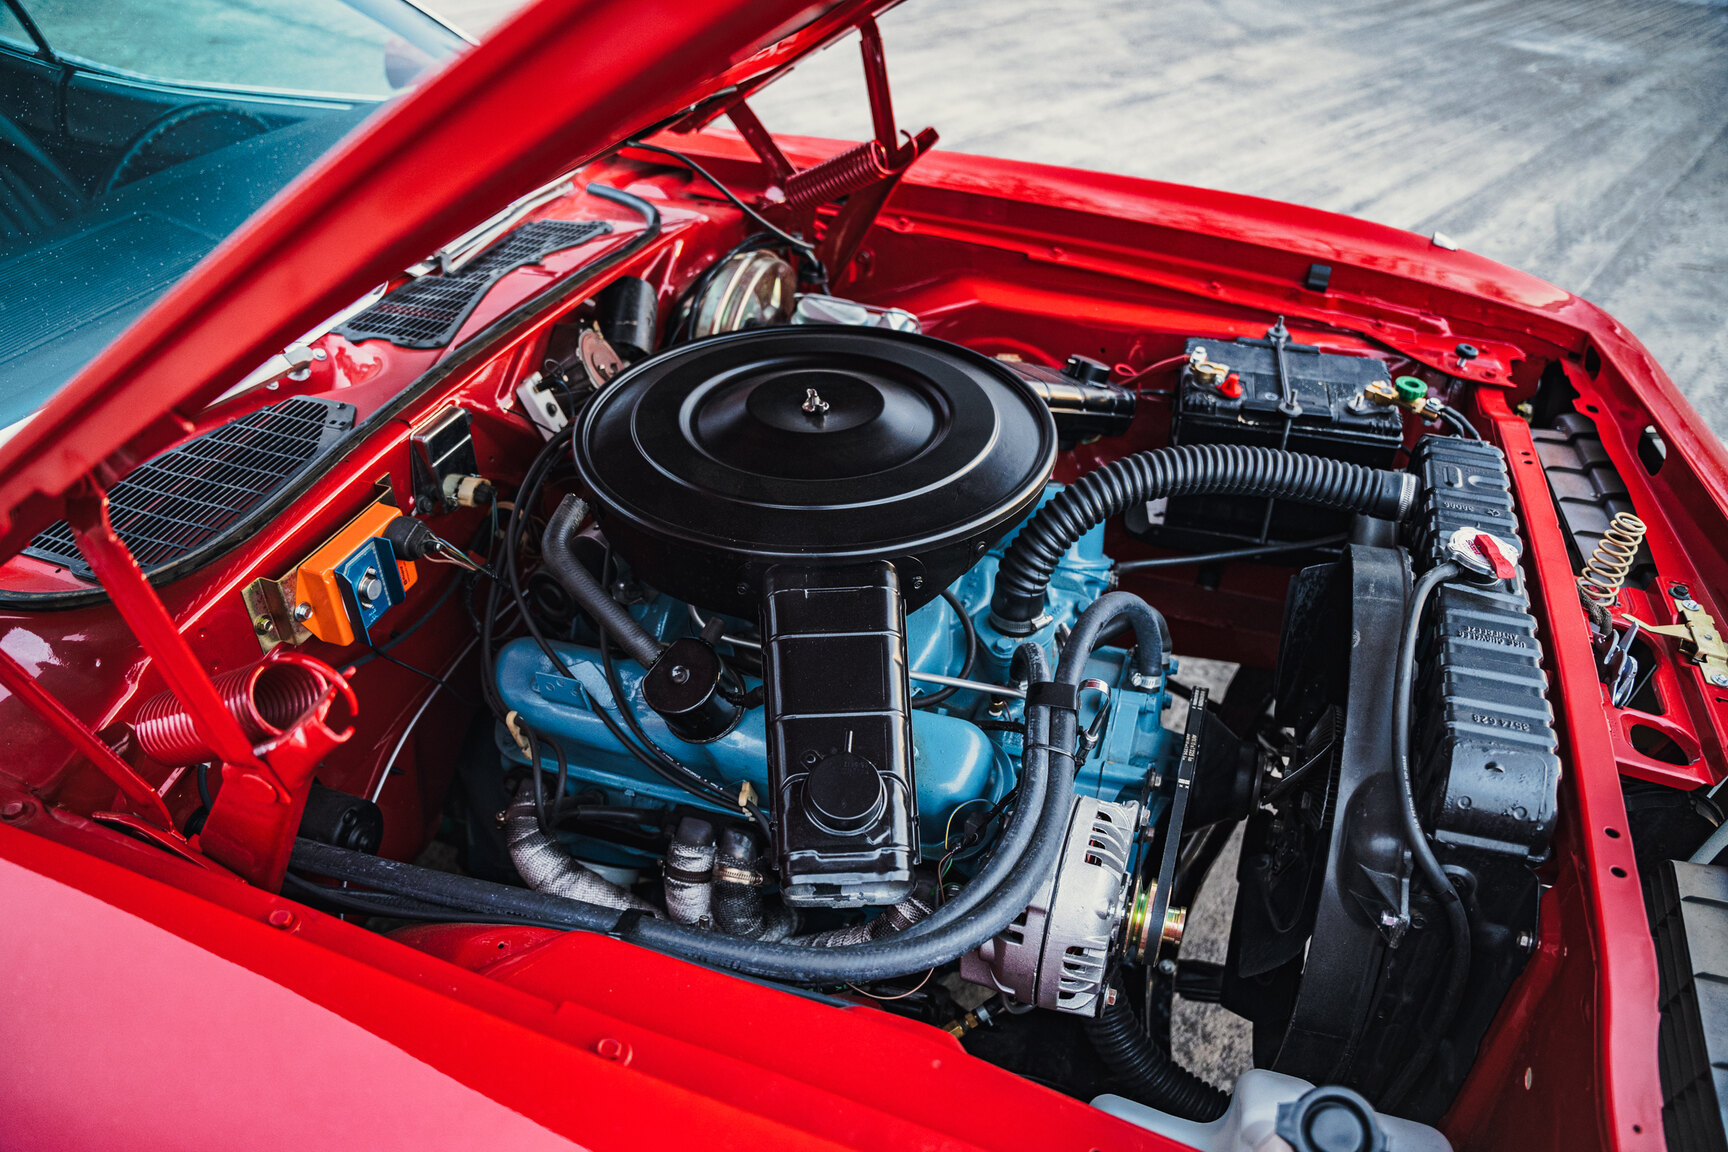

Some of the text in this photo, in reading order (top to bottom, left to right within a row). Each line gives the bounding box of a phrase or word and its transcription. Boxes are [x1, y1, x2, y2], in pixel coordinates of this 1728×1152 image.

[1457, 630, 1526, 649] USE CHRYSLER
[1463, 625, 1519, 640] ANTIFREEZE
[1471, 713, 1531, 732] 3574 628
